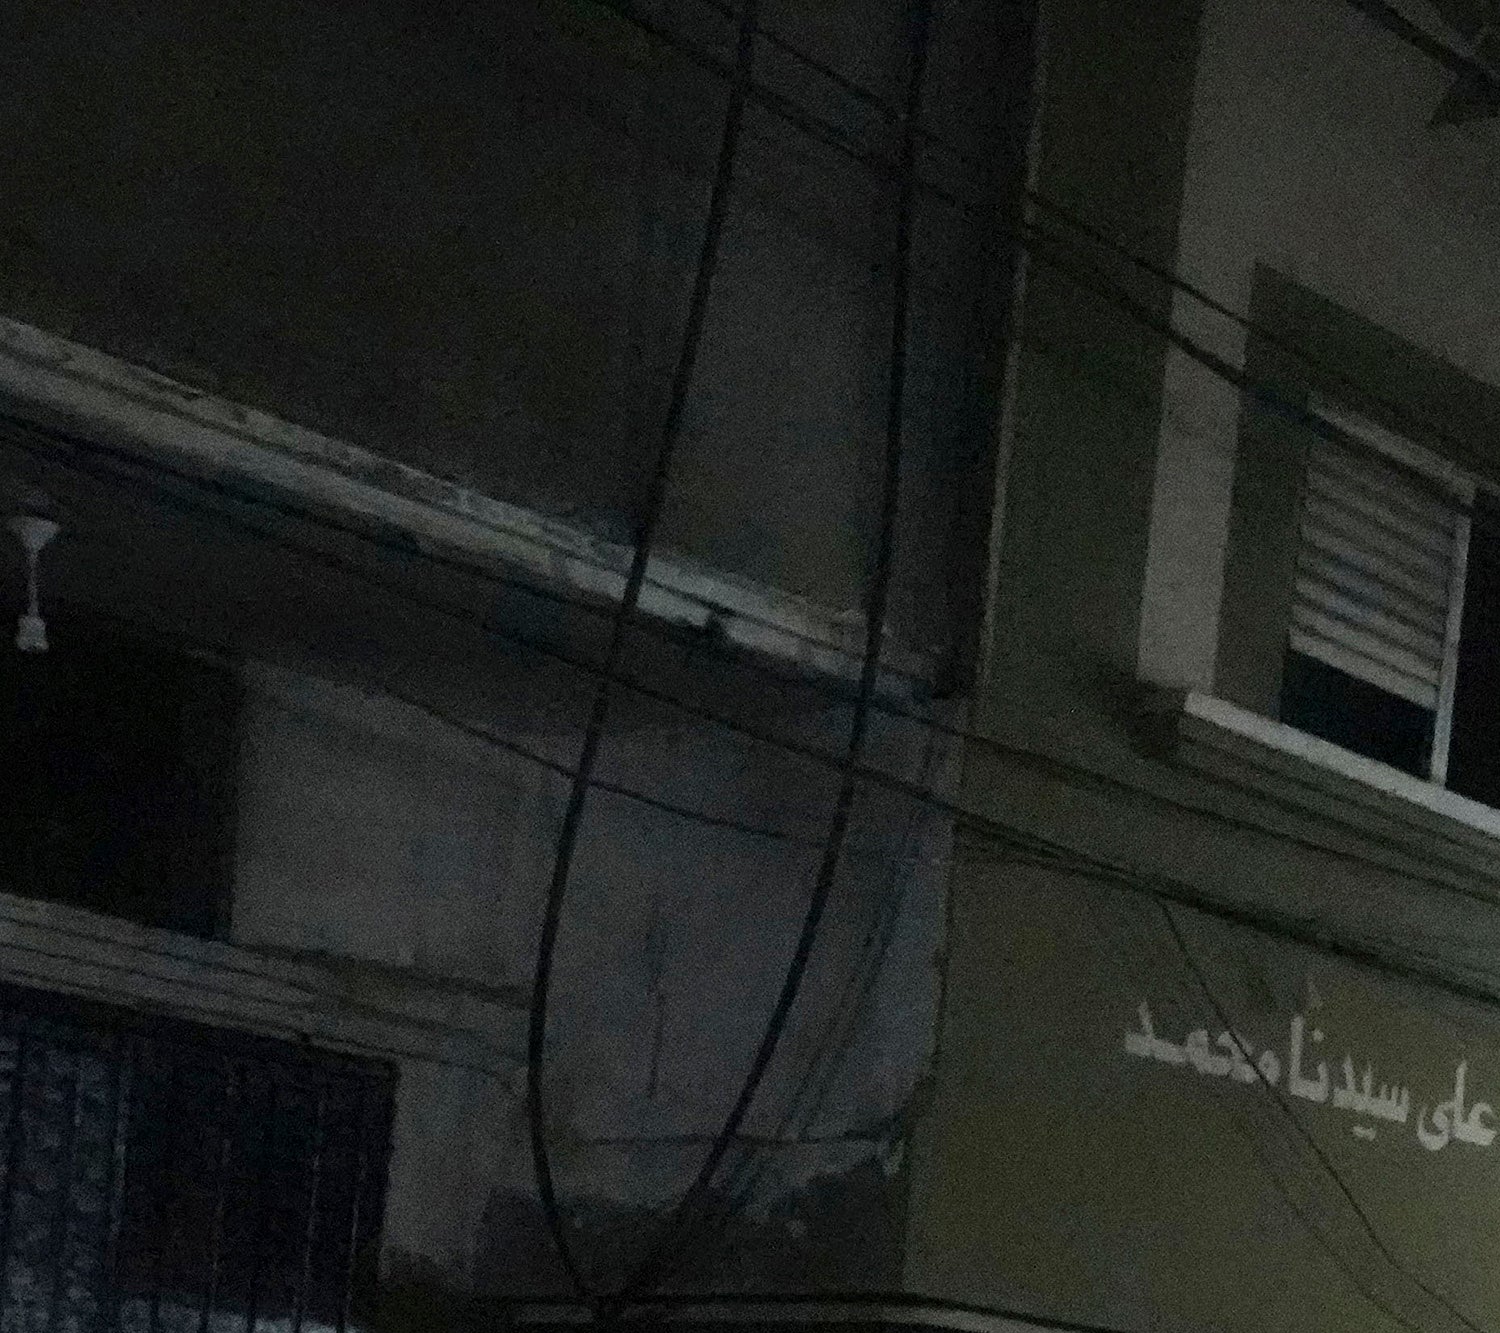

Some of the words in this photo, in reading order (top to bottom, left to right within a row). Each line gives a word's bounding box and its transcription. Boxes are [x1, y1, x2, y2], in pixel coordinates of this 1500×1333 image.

[1124, 1003, 1280, 1084] محمد
[1287, 1013, 1410, 1141] سيدنا
[1417, 1059, 1498, 1151] على
